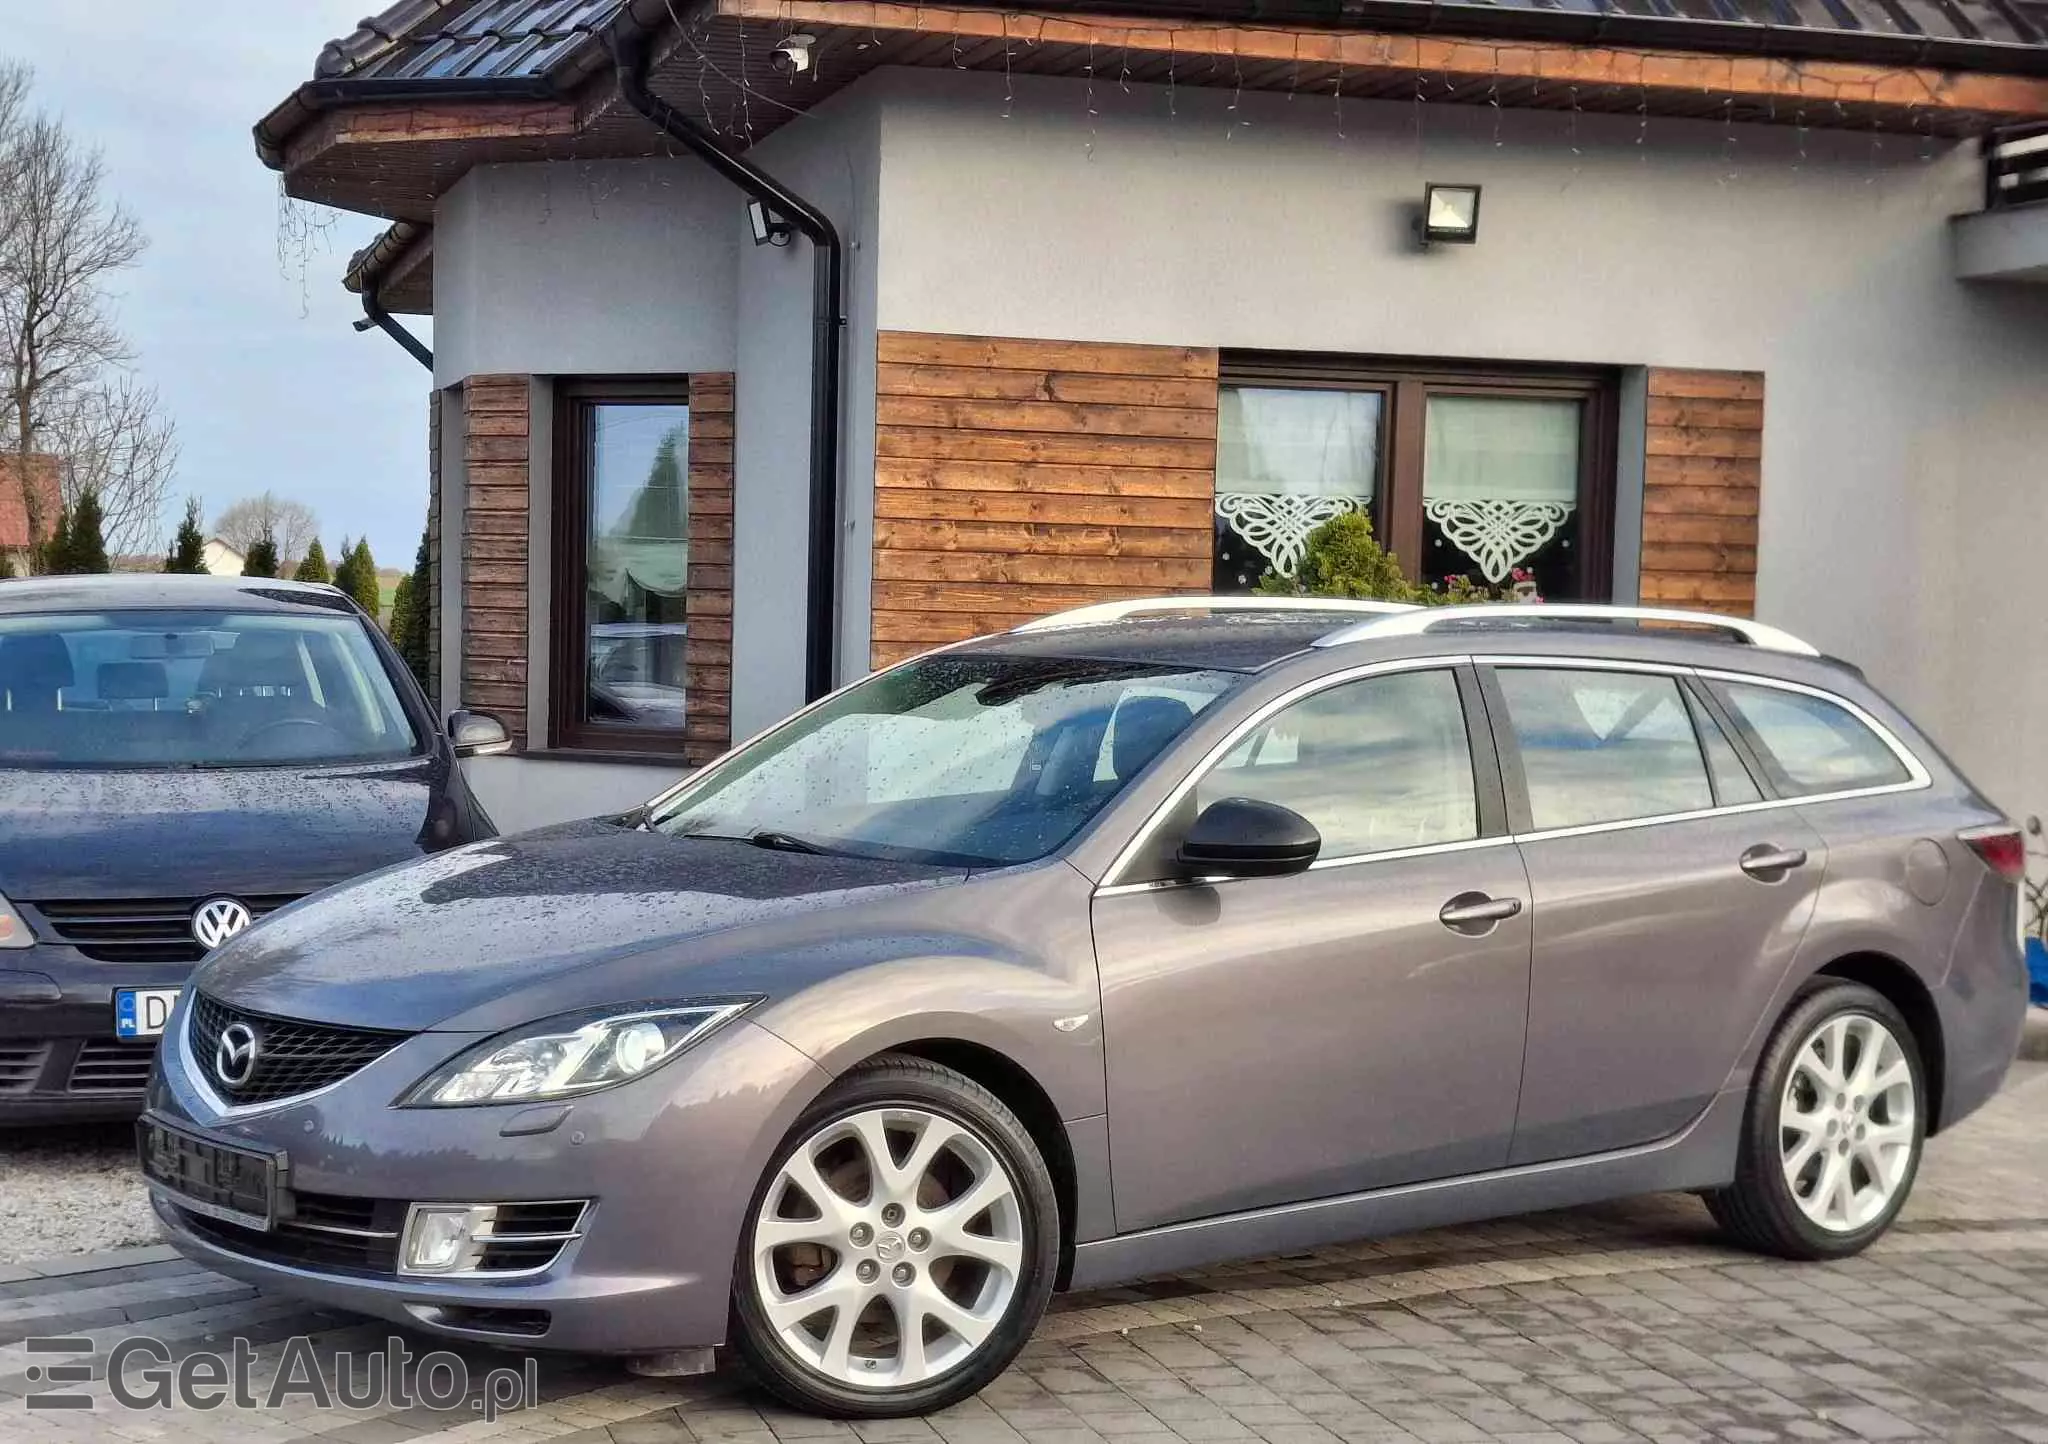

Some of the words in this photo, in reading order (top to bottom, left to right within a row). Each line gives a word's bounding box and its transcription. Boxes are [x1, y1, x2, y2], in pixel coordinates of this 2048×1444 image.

[195, 900, 250, 948] VW
[120, 1018, 136, 1029] PL
[146, 995, 180, 1029] D
